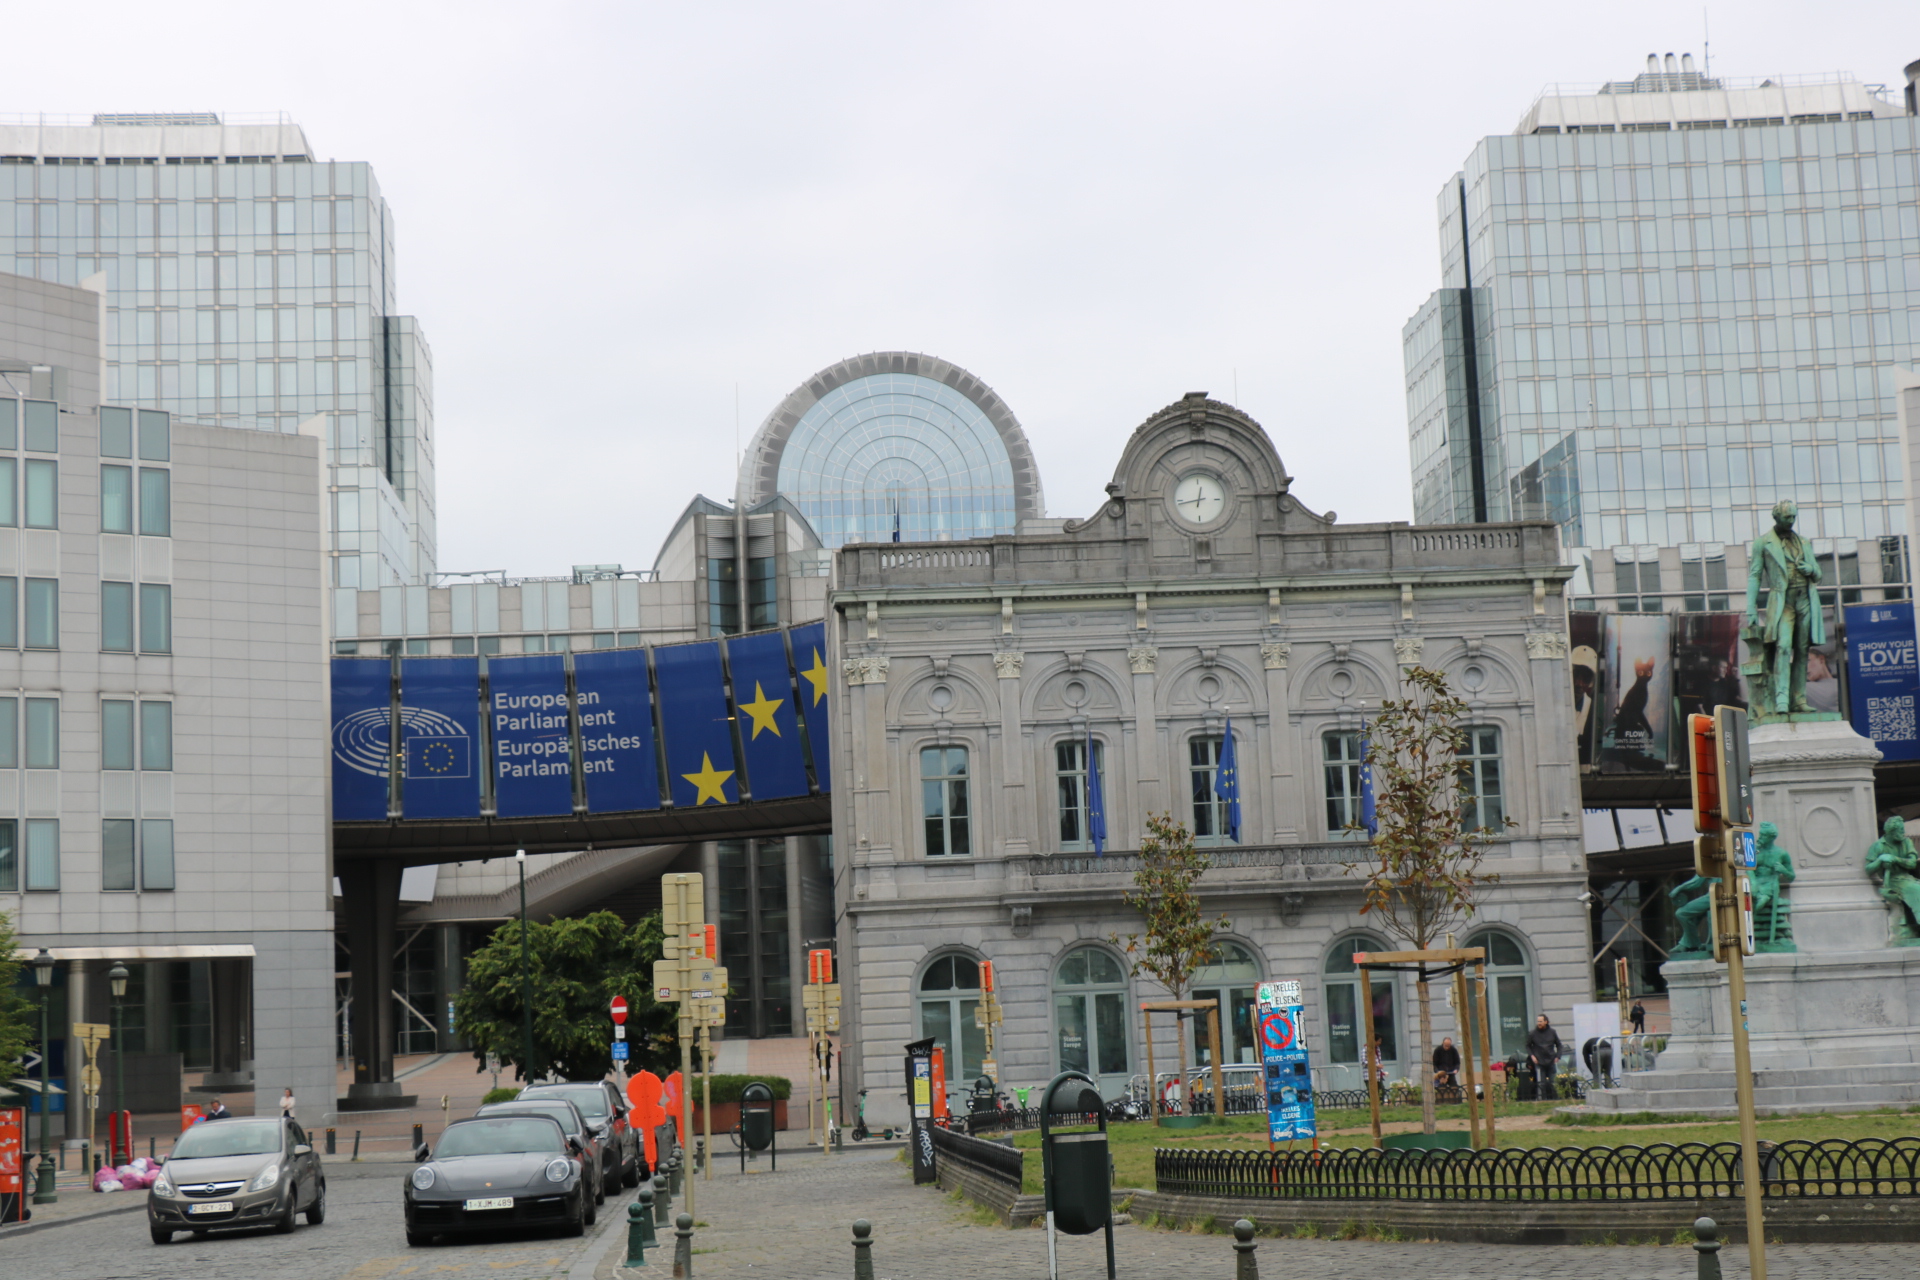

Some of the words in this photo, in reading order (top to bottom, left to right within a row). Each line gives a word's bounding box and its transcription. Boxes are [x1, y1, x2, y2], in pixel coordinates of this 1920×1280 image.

[1858, 642, 1887, 651] SHOW
[1889, 640, 1914, 648] YOUR
[1859, 648, 1916, 666] LOVE
[495, 692, 600, 710] European
[496, 710, 615, 731] Parliament
[498, 733, 640, 757] Europäisches
[499, 757, 615, 777] Parlament
[1273, 983, 1299, 992] IXELLES
[1275, 995, 1300, 1005] ELSENE
